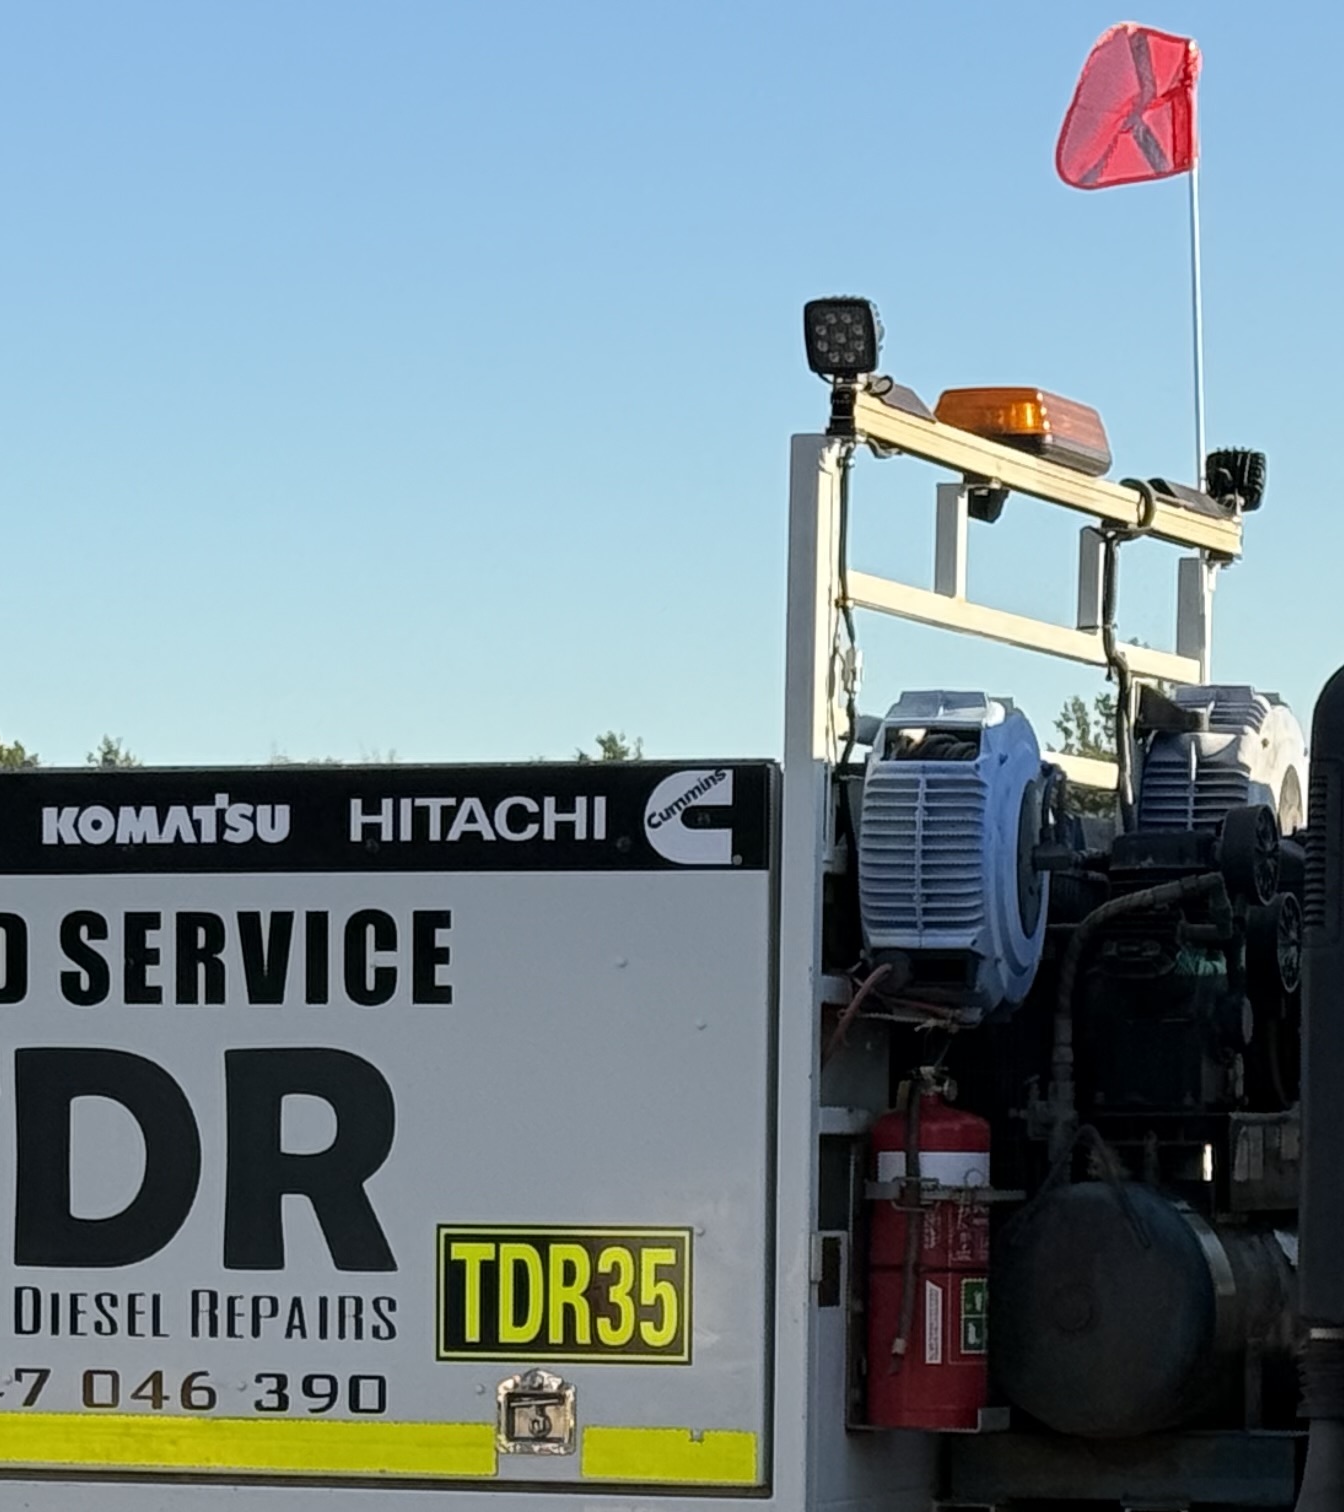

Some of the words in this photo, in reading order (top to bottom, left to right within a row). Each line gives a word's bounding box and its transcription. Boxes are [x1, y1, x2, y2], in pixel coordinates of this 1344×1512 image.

[42, 793, 291, 845] KOMATSU
[349, 795, 607, 842] HITACHI
[647, 768, 727, 829] Cummins
[59, 908, 454, 1007] SERVICE
[13, 1285, 170, 1338] DIESEL
[191, 1289, 398, 1341] REPAIRS
[450, 1242, 678, 1347] TDR35
[82, 1369, 218, 1411] 046
[254, 1372, 388, 1414] 390
